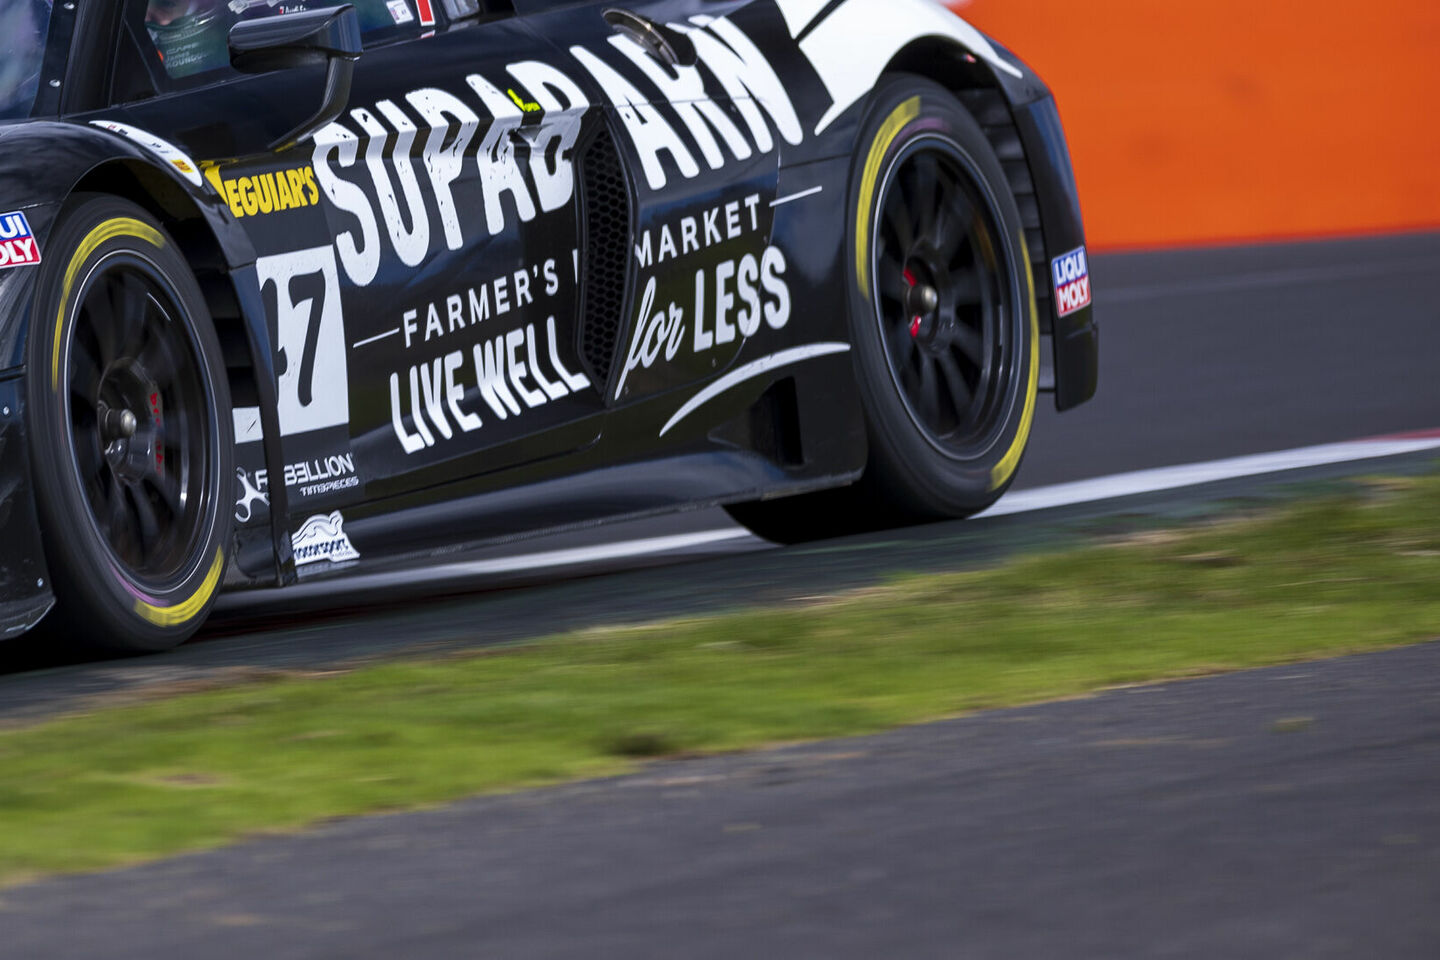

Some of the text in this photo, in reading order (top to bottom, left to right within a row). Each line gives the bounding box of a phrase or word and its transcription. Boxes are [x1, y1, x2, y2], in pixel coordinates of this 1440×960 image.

[311, 14, 803, 286] SUPABARN
[403, 258, 559, 349] FARMER'S
[1054, 250, 1087, 285] LIQUI
[1058, 274, 1088, 313] MOLY
[390, 245, 792, 455] LIVE WELL for LESS
